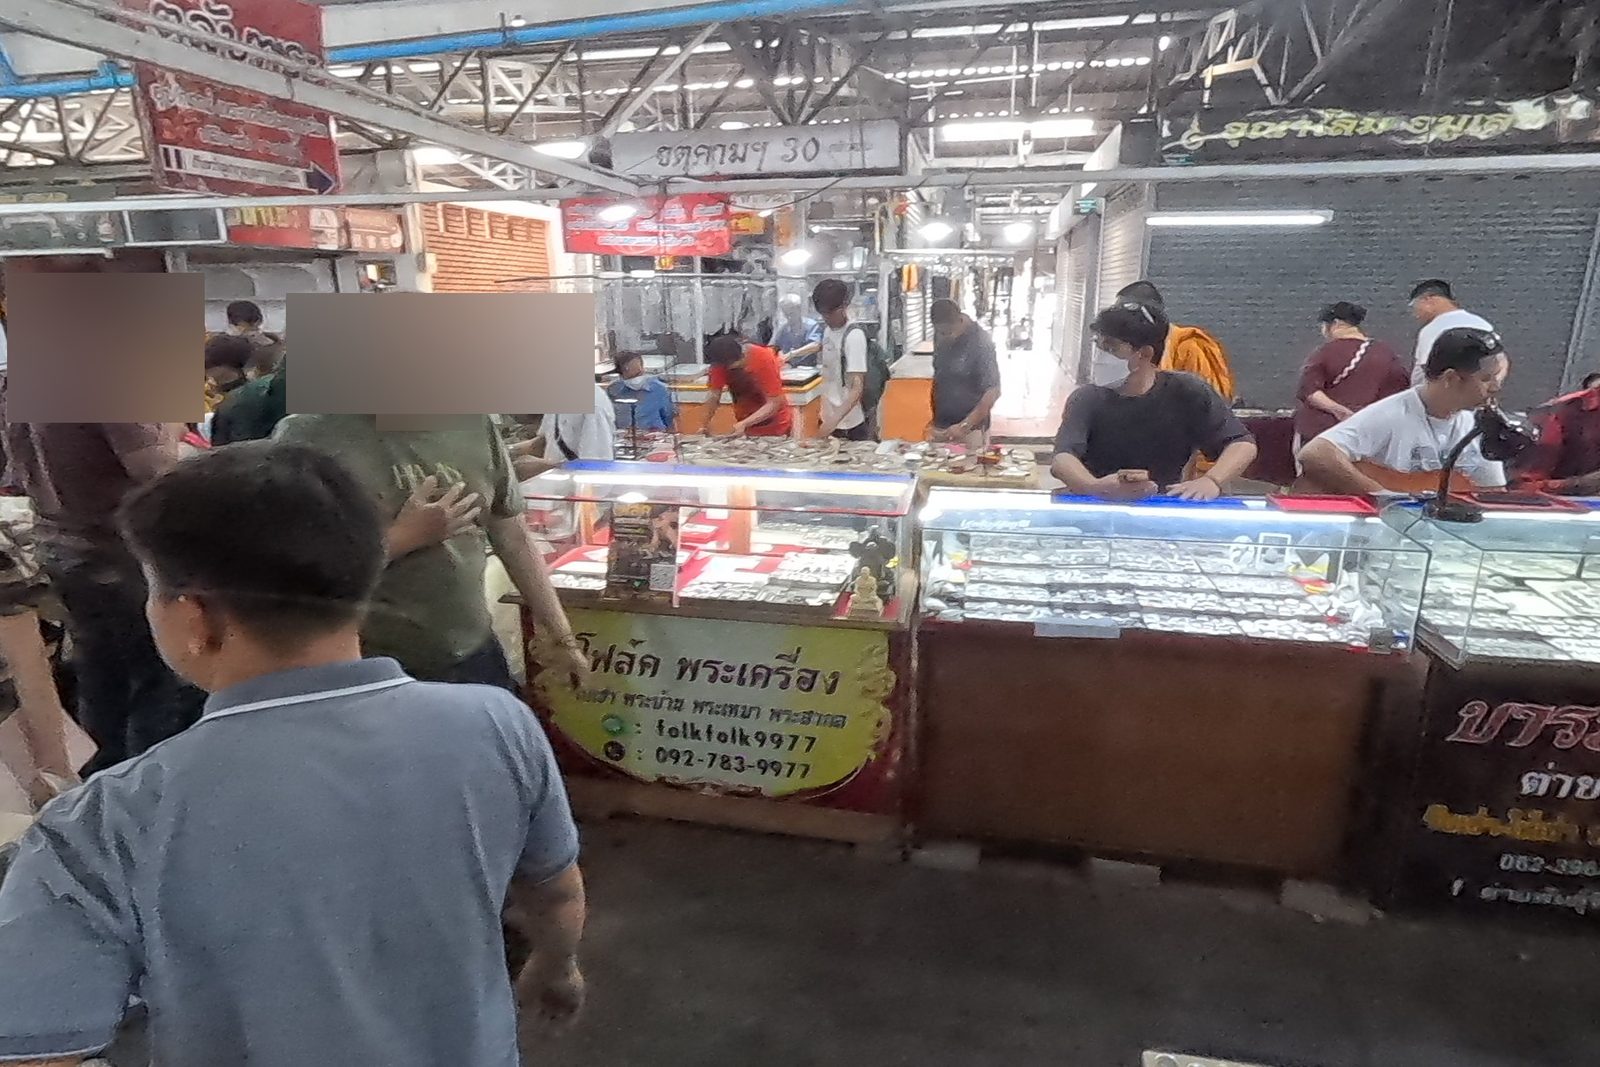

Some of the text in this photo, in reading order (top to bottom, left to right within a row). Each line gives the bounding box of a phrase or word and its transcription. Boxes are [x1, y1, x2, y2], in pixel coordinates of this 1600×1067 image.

[781, 137, 820, 162] 30
[656, 719, 817, 753] folkfolk9977
[655, 746, 810, 779] 092-783-9977
